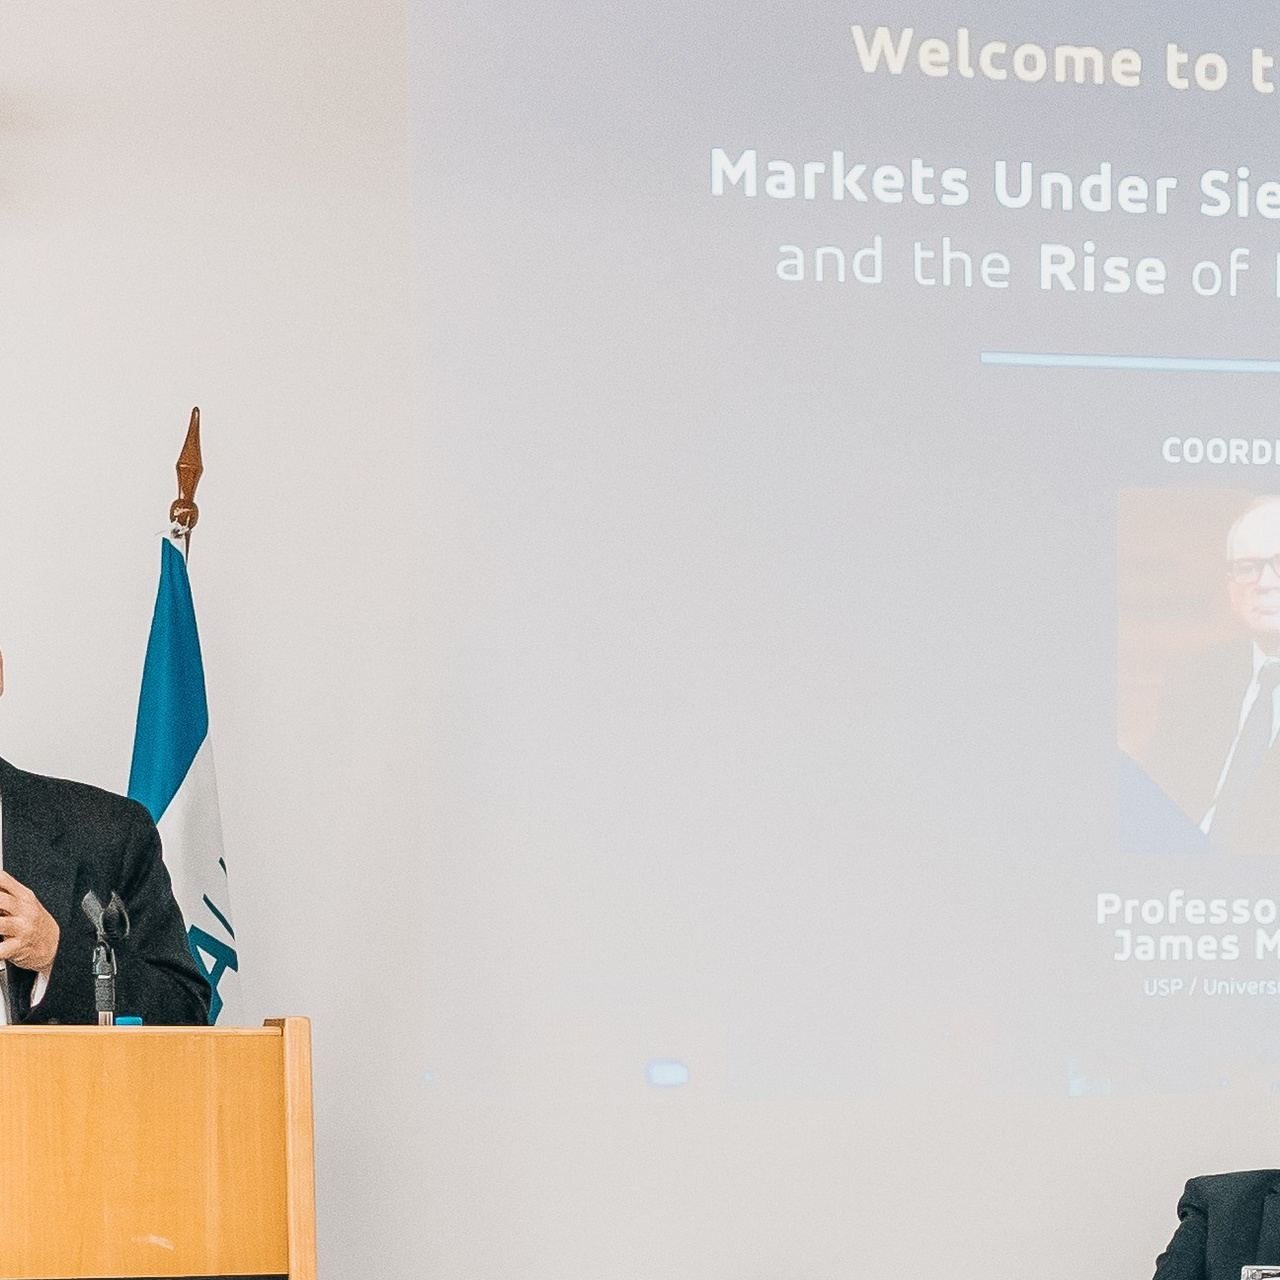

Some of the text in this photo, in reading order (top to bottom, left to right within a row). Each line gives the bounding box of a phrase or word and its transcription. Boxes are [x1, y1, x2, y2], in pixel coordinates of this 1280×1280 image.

[852, 26, 1141, 86] Welcome
[1167, 44, 1227, 90] to
[712, 149, 968, 205] Markets
[996, 161, 1177, 213] Under
[777, 236, 882, 284] and
[915, 237, 1010, 288] the
[1041, 241, 1166, 294] Rise
[1193, 248, 1249, 296] of
[1115, 929, 1239, 960] James
[1143, 977, 1184, 997] USP
